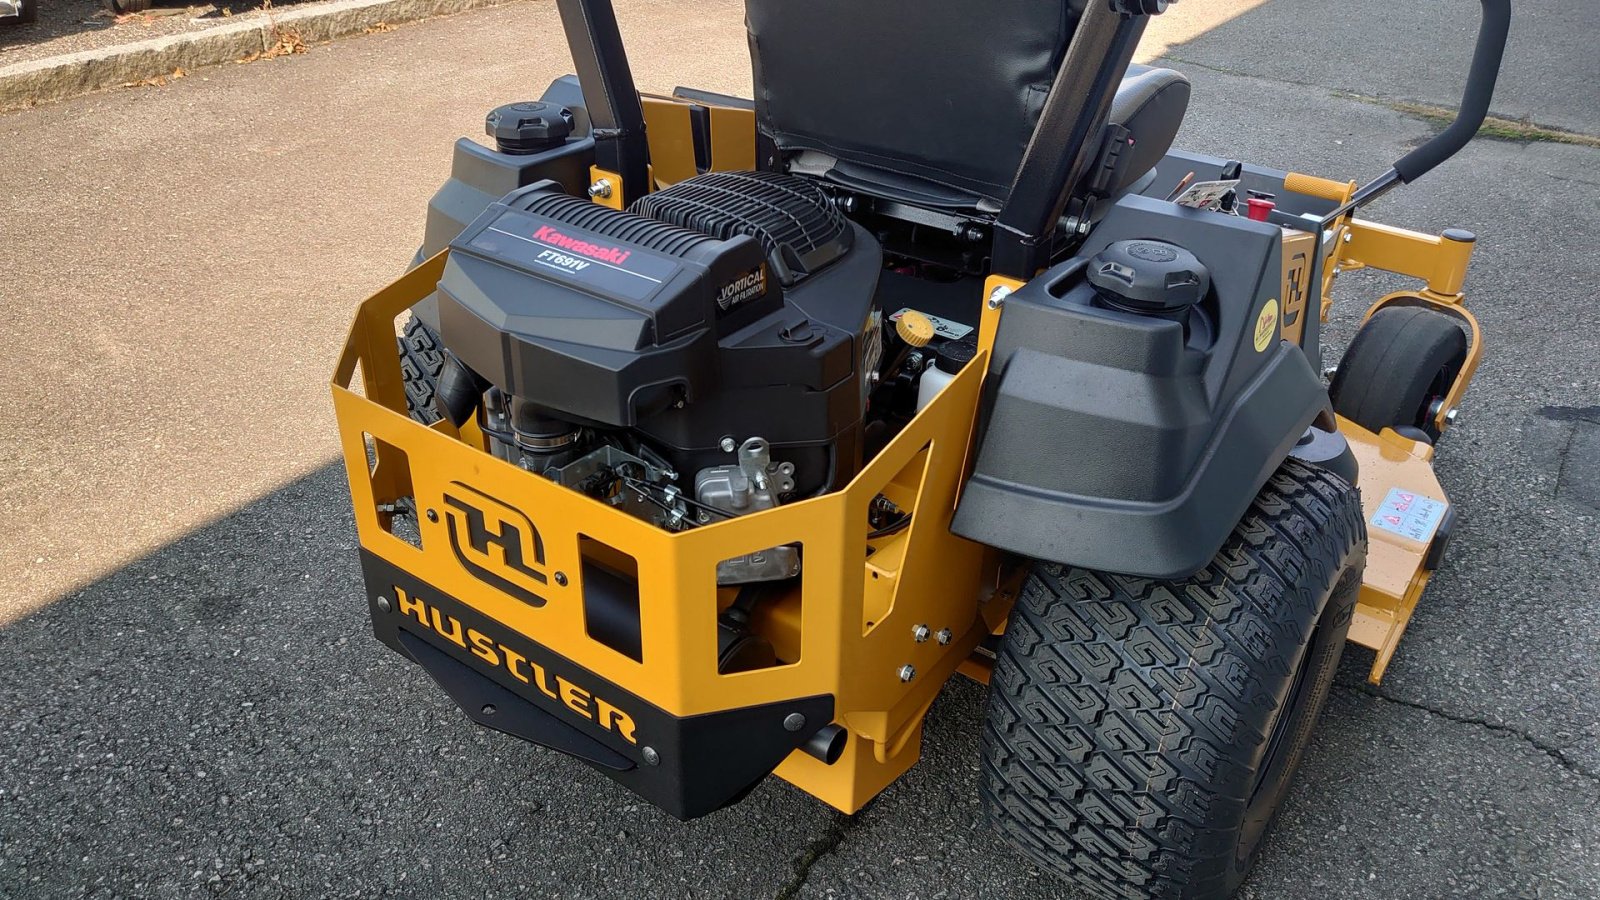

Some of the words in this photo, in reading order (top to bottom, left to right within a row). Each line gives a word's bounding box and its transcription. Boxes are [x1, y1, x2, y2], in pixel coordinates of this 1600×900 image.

[532, 225, 631, 265] Kawasaki
[537, 249, 590, 271] FT691V
[721, 269, 764, 299] VORTICAL
[731, 294, 740, 305] AIR
[740, 282, 764, 300] FILTRATION
[393, 585, 637, 744] HUSTLER
